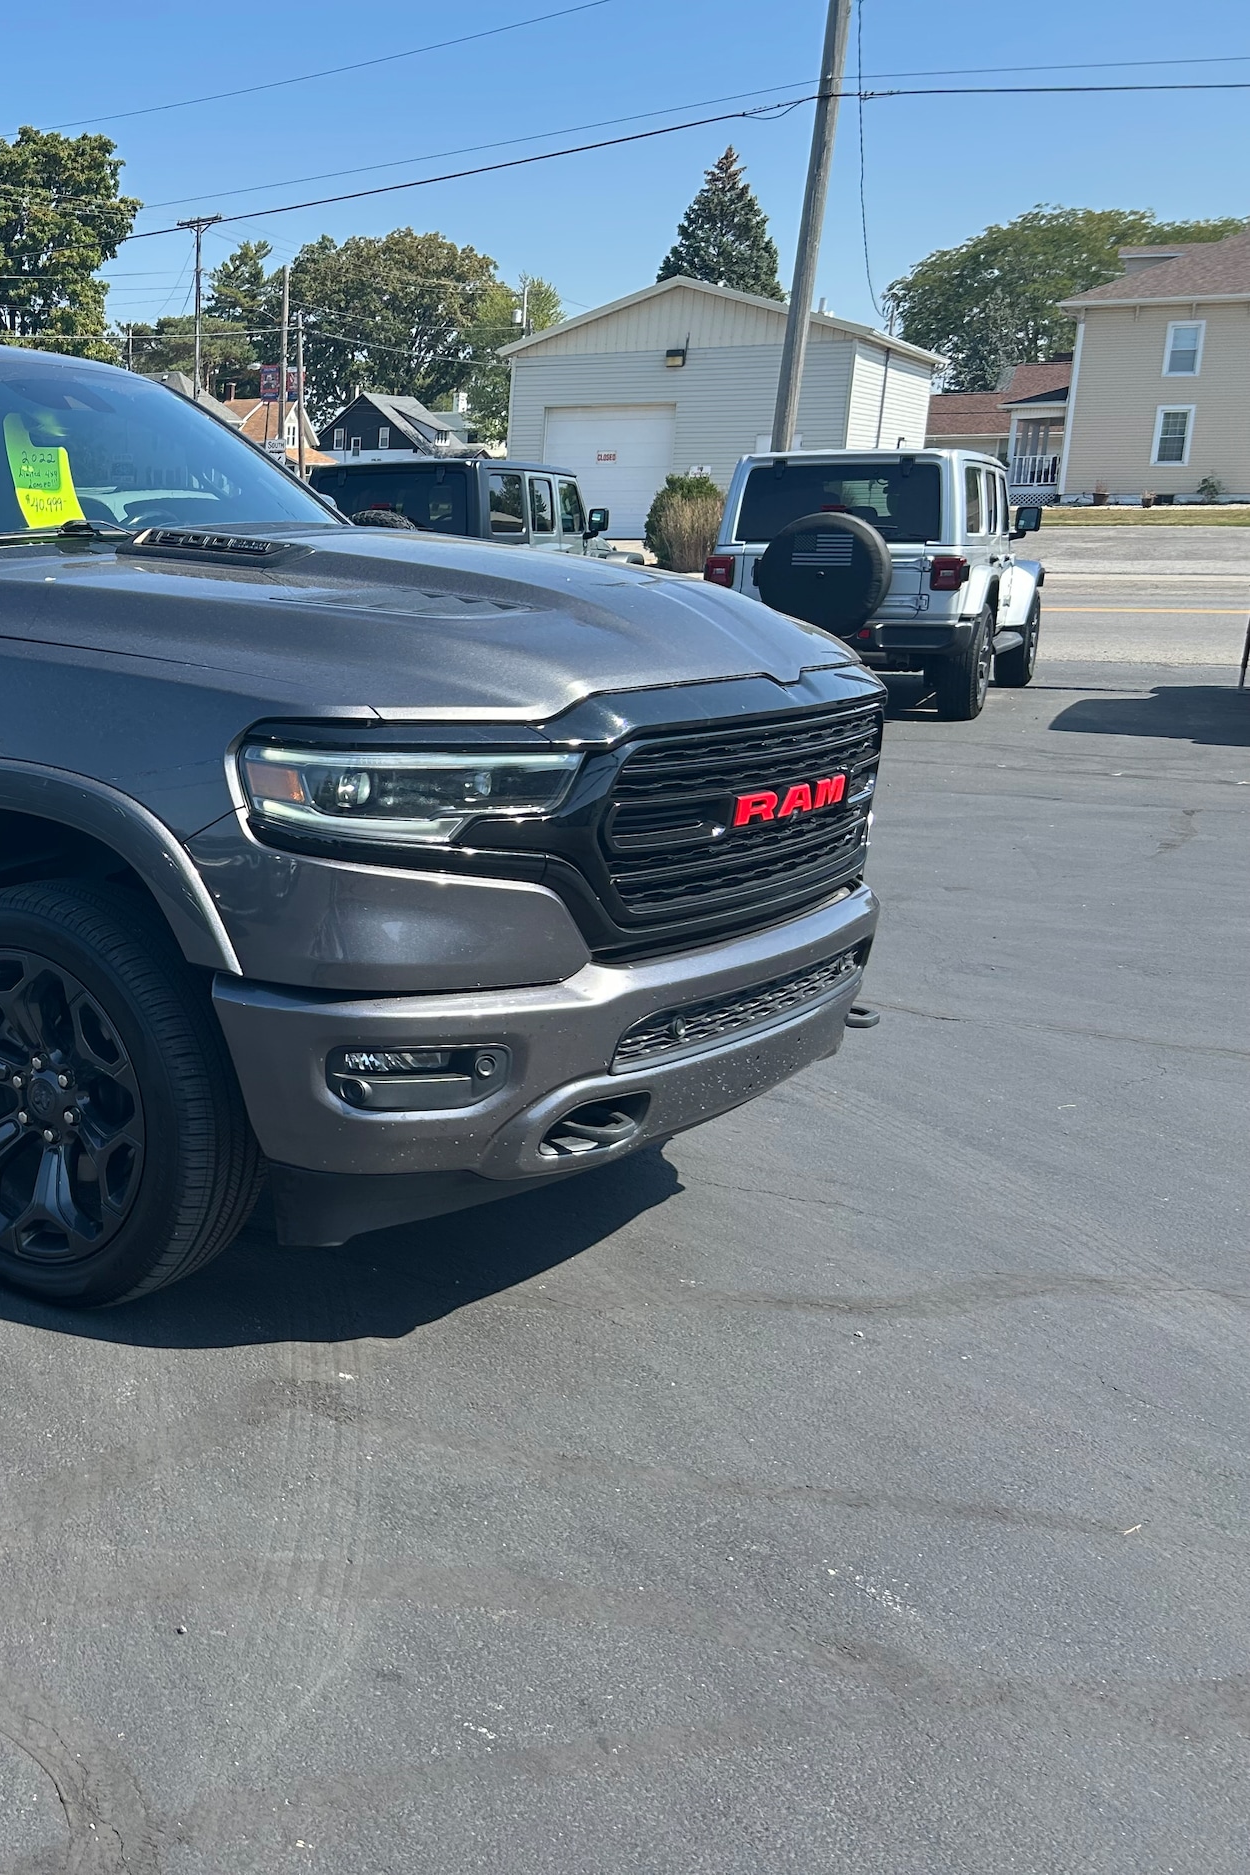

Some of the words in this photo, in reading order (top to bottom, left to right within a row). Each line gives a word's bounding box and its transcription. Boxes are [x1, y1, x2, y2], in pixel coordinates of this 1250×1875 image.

[267, 441, 285, 450] SOUTH
[21, 451, 56, 464] 2022
[597, 453, 616, 461] CLOSED
[734, 774, 846, 826] RAM
